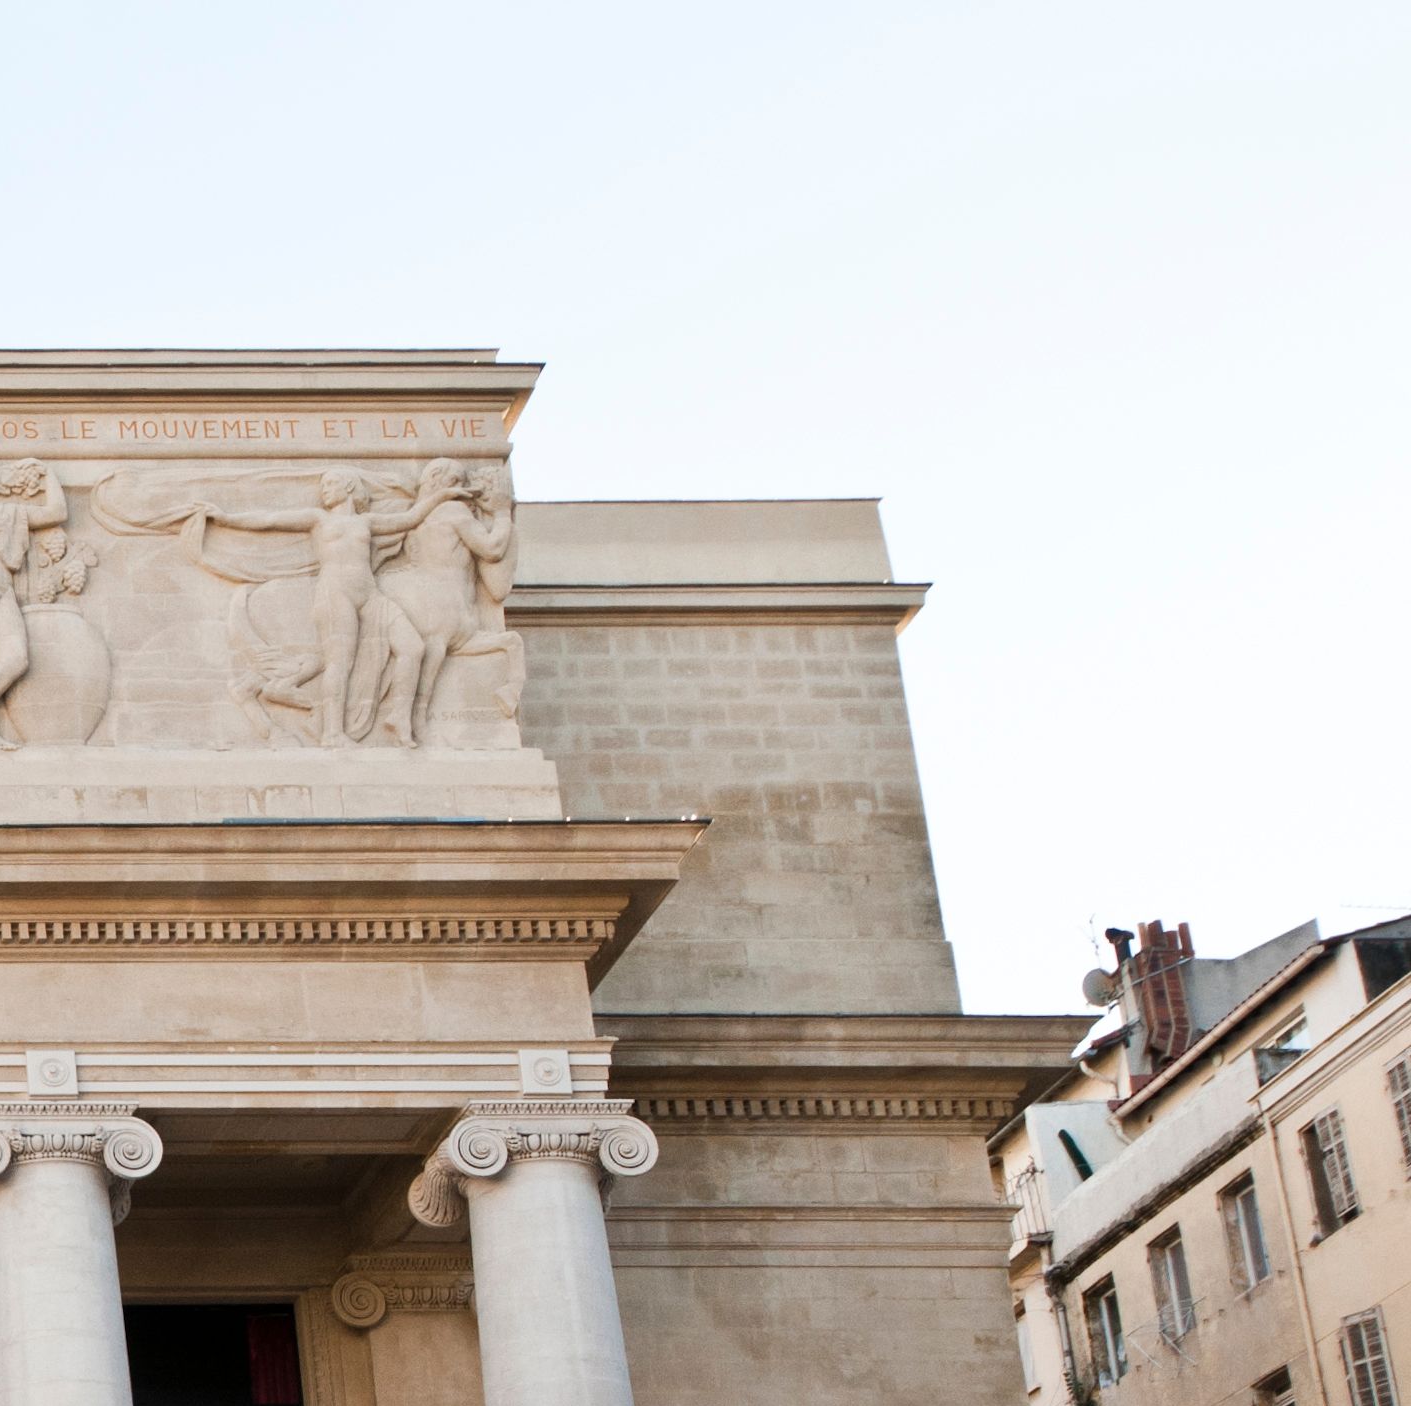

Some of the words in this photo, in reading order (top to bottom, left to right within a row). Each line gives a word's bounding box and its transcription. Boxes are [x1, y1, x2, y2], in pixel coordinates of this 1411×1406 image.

[61, 420, 98, 439] LE
[119, 420, 301, 439] MOUVEMENT
[322, 419, 360, 438] ET
[382, 419, 419, 438] LA
[441, 418, 488, 438] VIE
